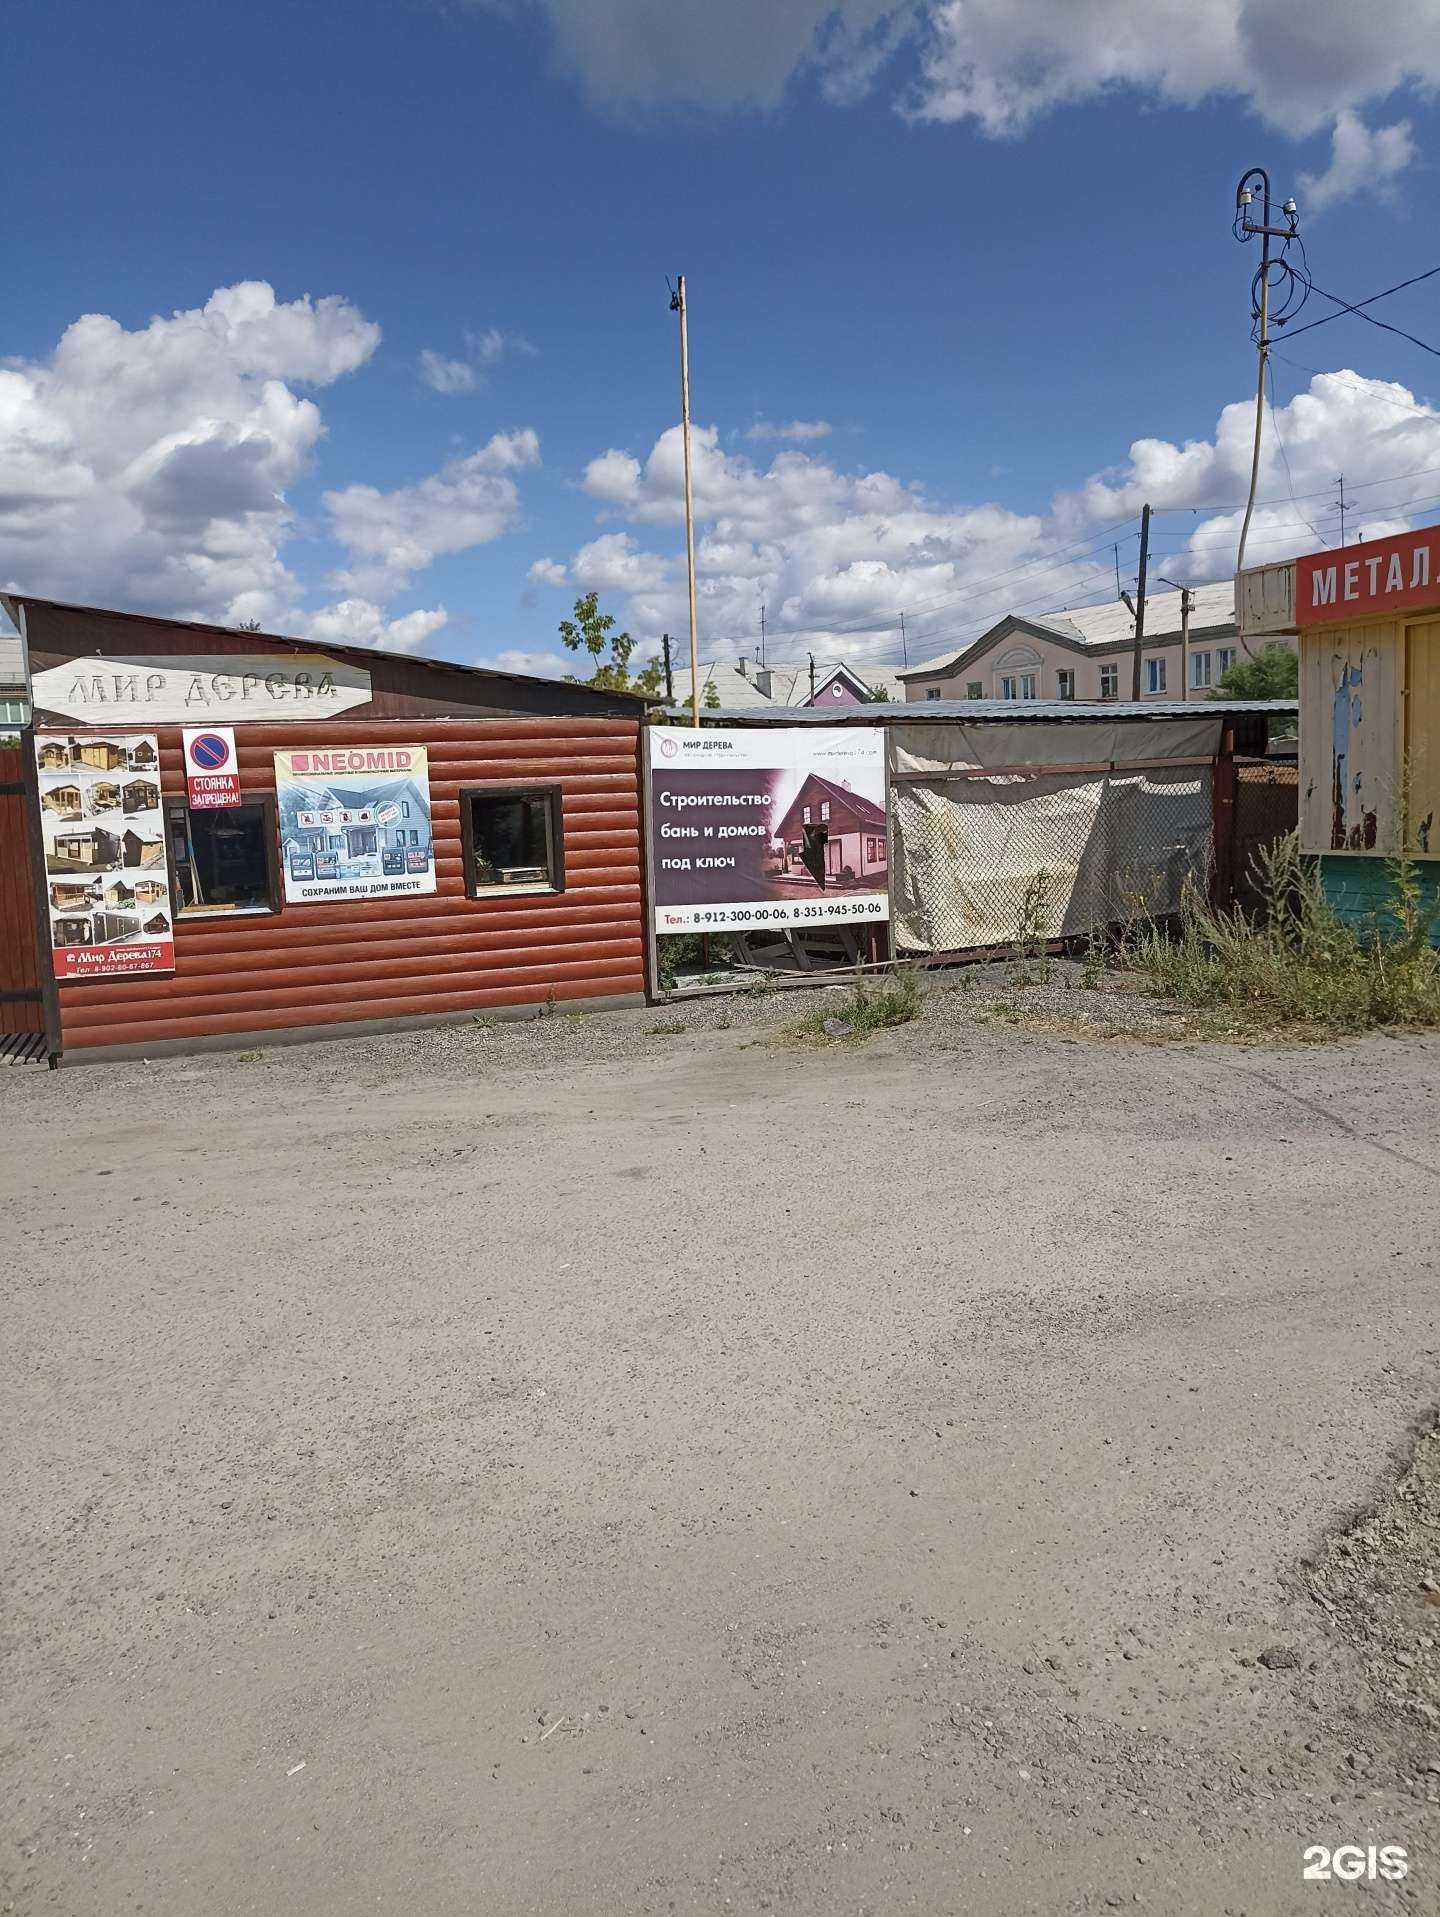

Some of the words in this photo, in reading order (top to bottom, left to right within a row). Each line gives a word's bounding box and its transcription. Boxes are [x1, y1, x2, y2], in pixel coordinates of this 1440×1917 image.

[1311, 545, 1440, 607] МЕТАЛ
[68, 674, 166, 704] МИР
[184, 671, 338, 708] ДЕРЕВА
[682, 741, 701, 749] МИР
[702, 741, 733, 750] ДЕРЕВА
[312, 751, 412, 772] NEOMID
[193, 776, 235, 791] СТОЯНКА
[191, 792, 240, 806] ЗАПРЕЩЕНА!
[659, 791, 772, 811] Строительство
[660, 822, 699, 838] бань
[703, 826, 714, 837] и
[717, 825, 767, 839] домов
[661, 858, 692, 870] под
[695, 857, 736, 868] ключ
[301, 886, 348, 898] СОХРАНИМ
[349, 885, 368, 894] ВАШ
[370, 883, 389, 894] ДОМ
[390, 881, 421, 891] ВМЕСТЕ
[664, 914, 690, 925] Тел.:
[693, 909, 789, 924] 8-912-300-00-06,
[793, 902, 882, 918] 8-351-945-50-06
[77, 952, 105, 964] Мир
